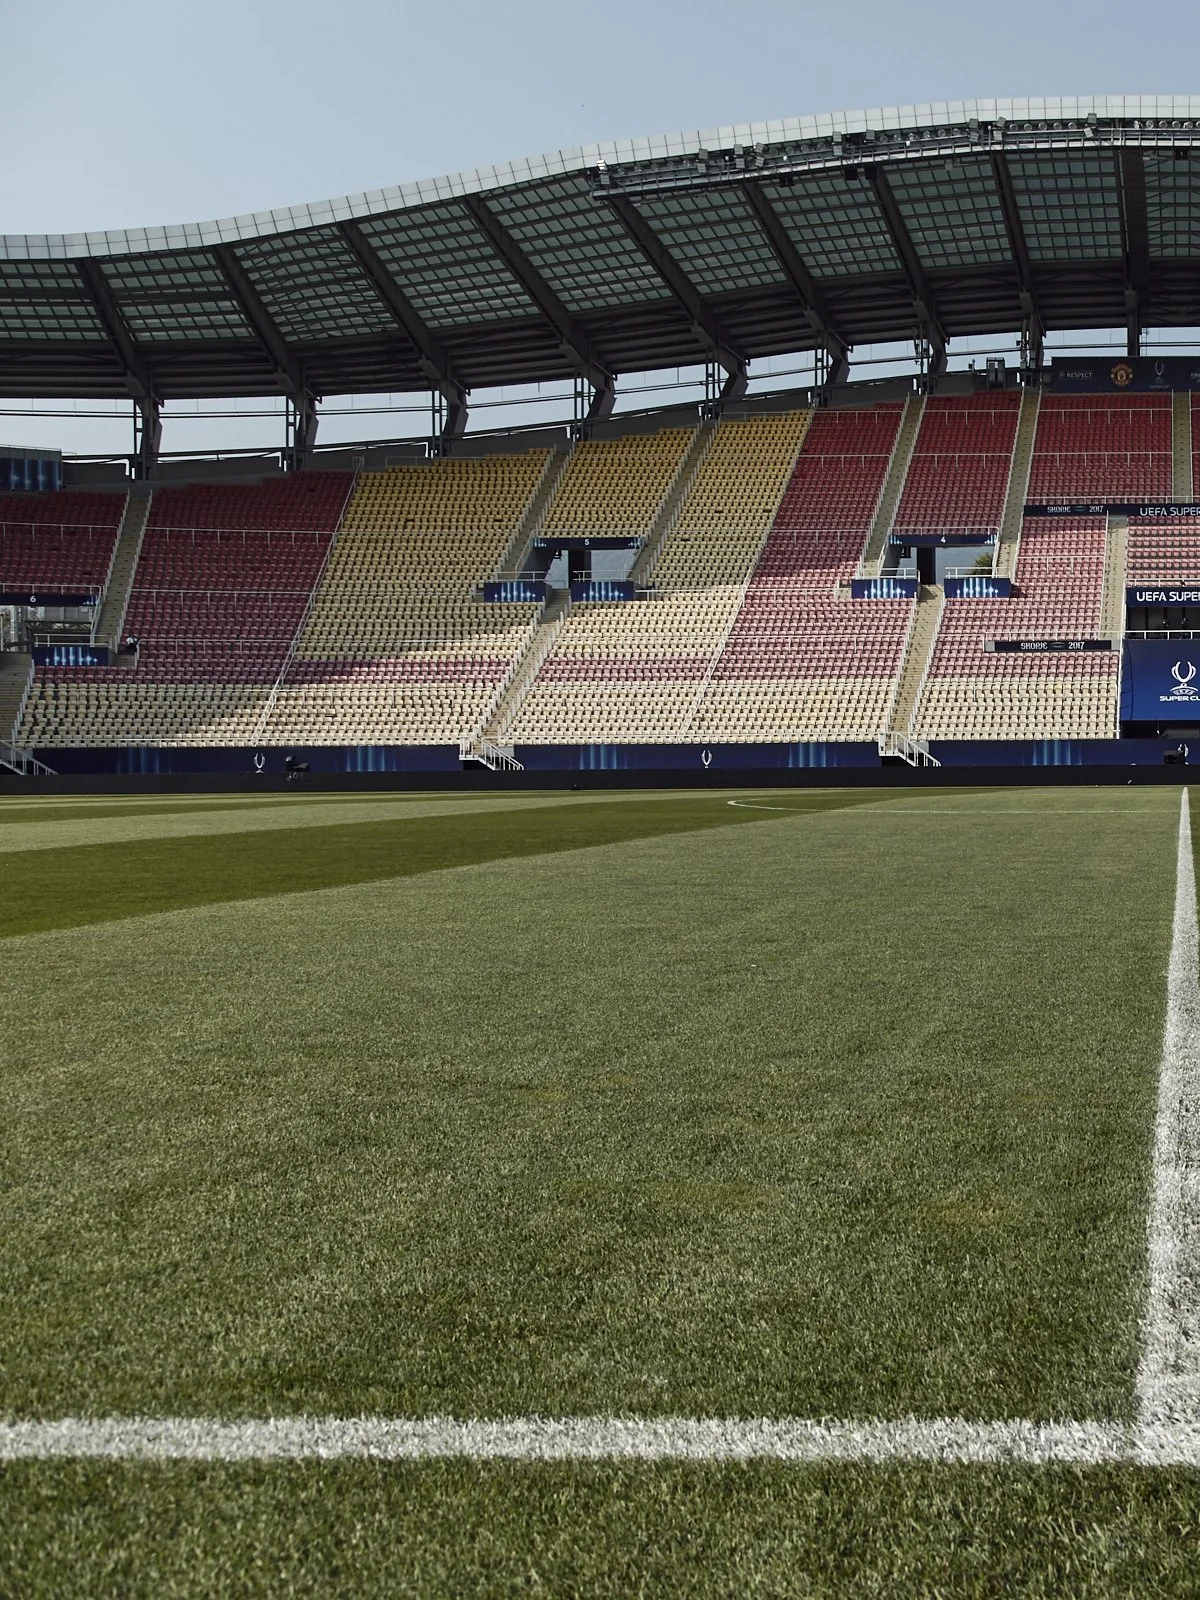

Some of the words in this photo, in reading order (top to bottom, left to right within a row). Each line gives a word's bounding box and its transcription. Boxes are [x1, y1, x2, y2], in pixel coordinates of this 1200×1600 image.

[1089, 505, 1104, 513] 2017
[1139, 507, 1168, 516] UEFA
[1136, 591, 1167, 601] UEFA
[1020, 642, 1048, 650] SKOPJE
[1068, 641, 1085, 650] 2017
